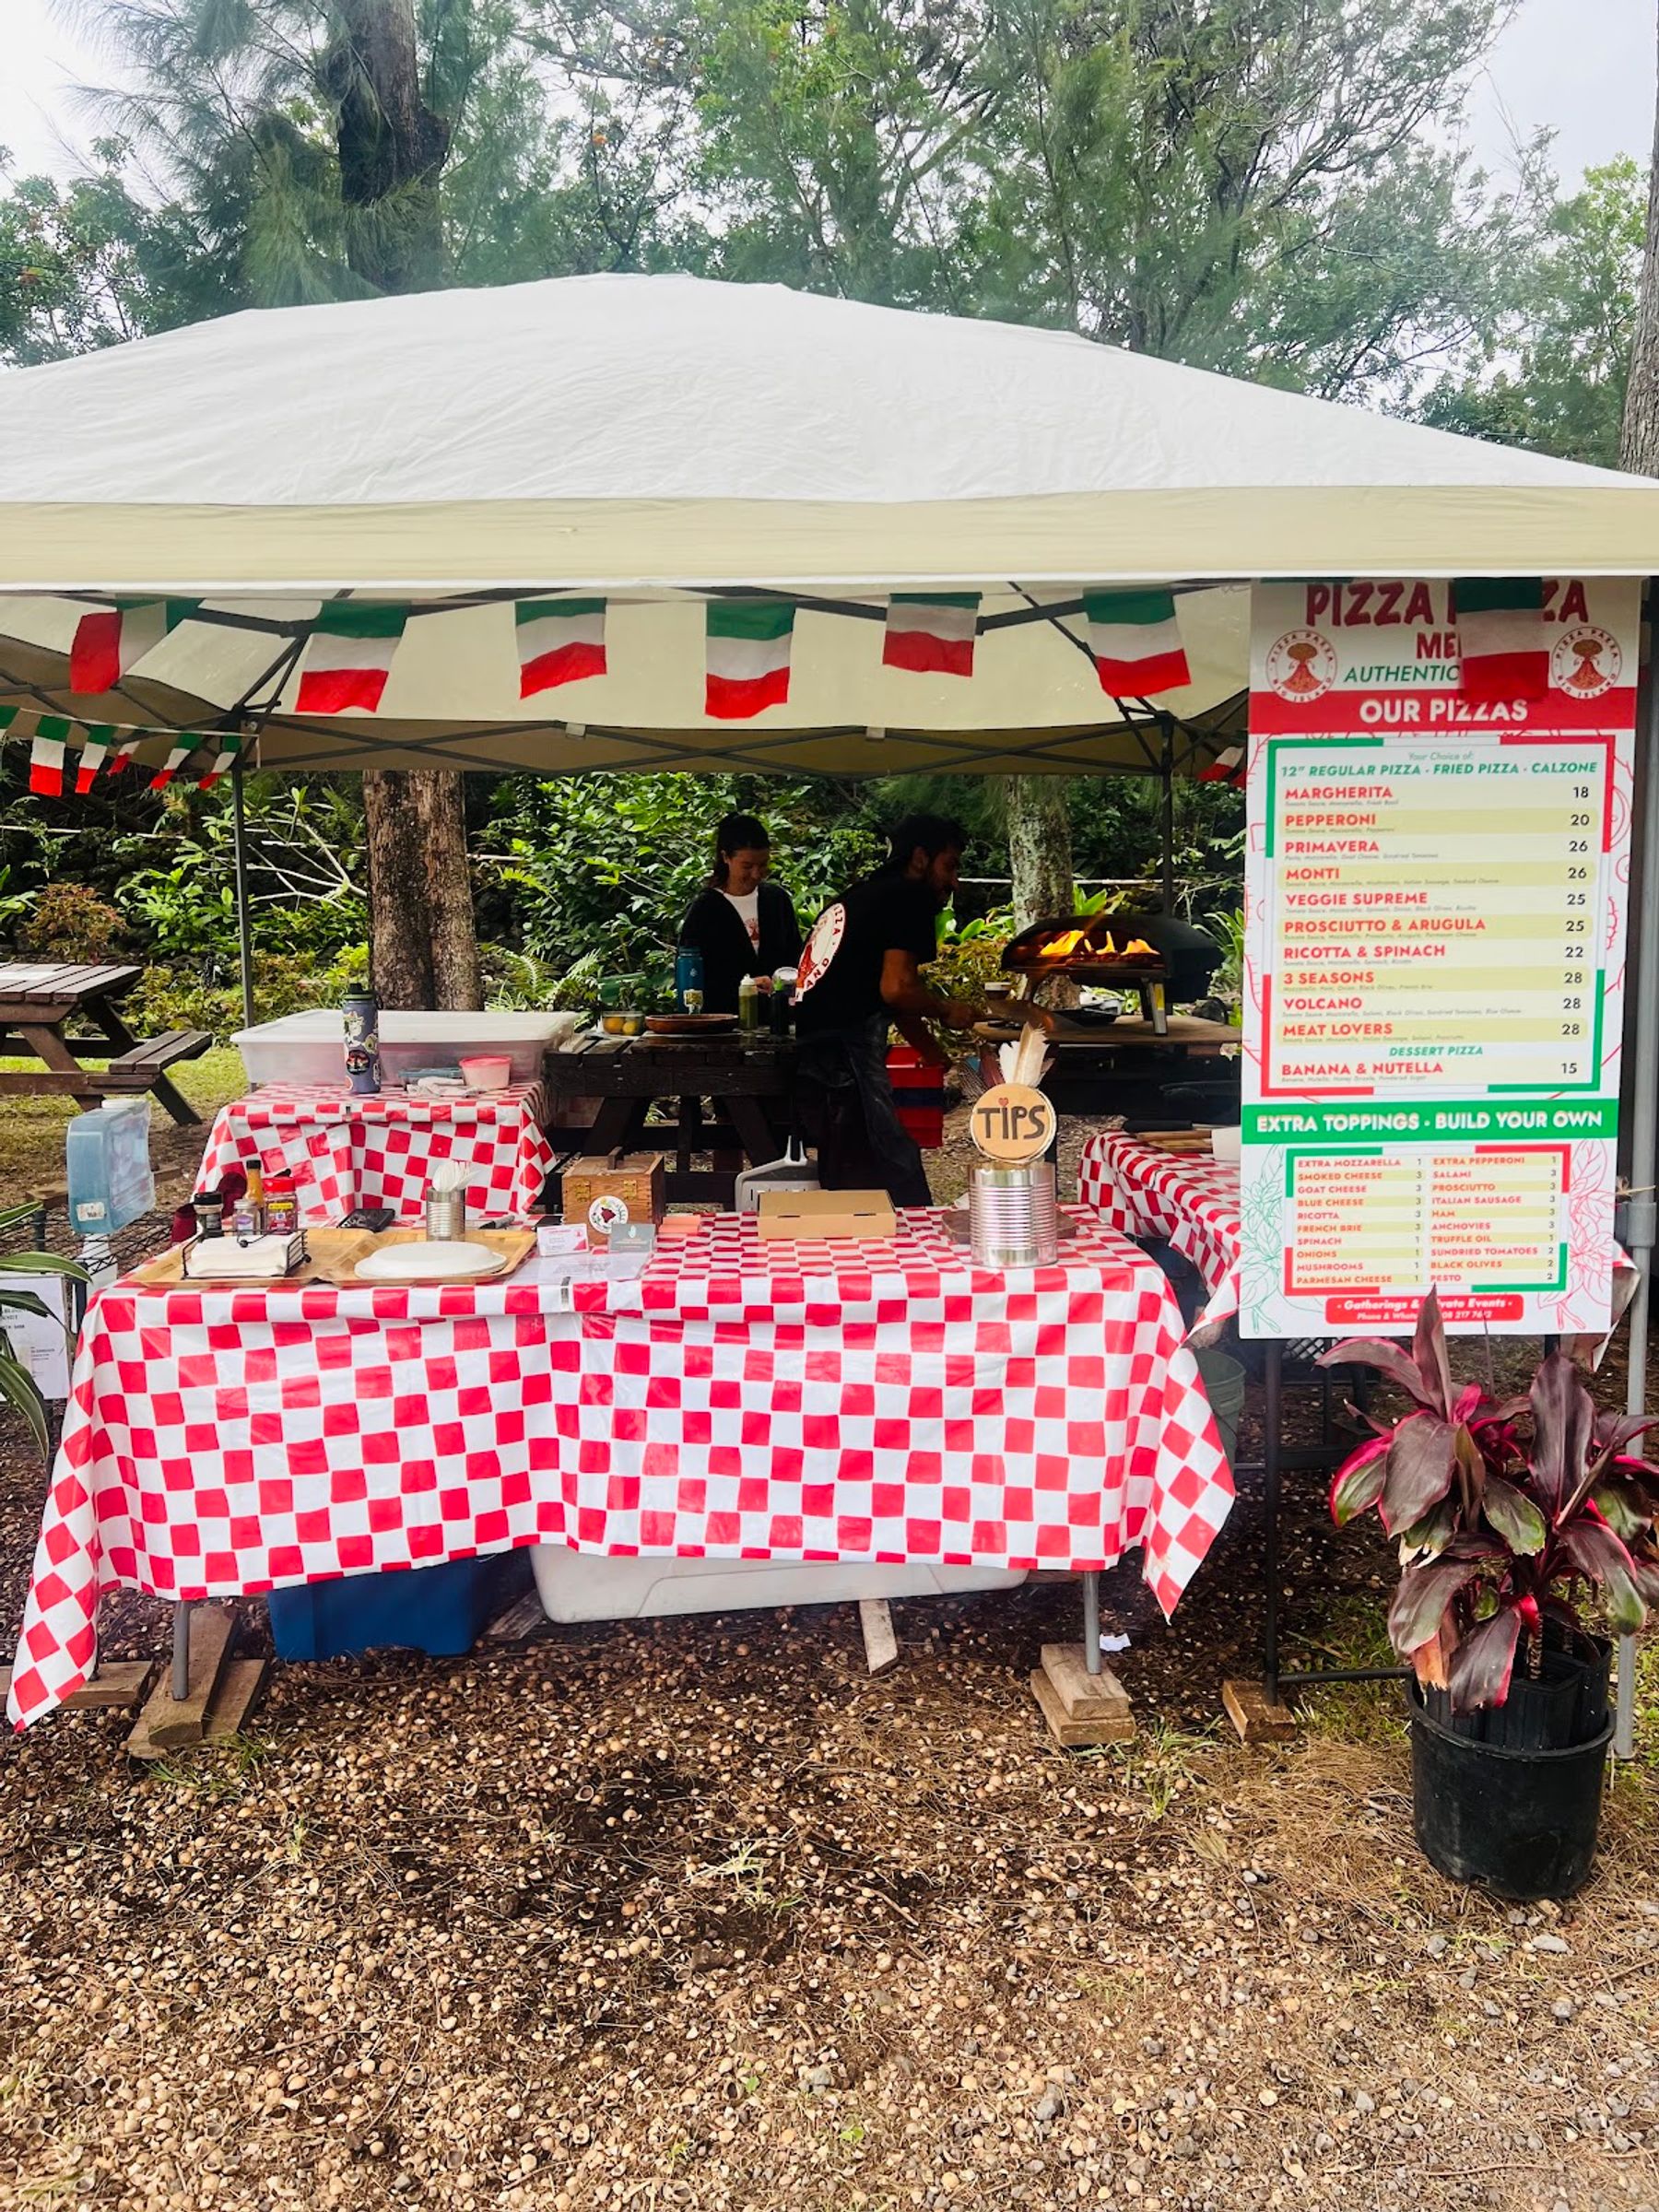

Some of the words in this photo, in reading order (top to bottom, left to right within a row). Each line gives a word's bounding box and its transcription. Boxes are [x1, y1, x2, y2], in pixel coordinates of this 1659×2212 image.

[1305, 582, 1434, 627] PIZZA
[1344, 665, 1461, 683] AUTHENTIC
[1359, 700, 1420, 724] OUR
[1430, 698, 1528, 723] PIZZAS
[1430, 751, 1461, 760] Choice
[1309, 764, 1375, 776] REGULAR
[1380, 764, 1421, 775] PIZZA
[1433, 763, 1474, 775] FRIED
[1477, 763, 1519, 774] PIZZA
[1532, 762, 1598, 773] CALZONE
[1285, 786, 1393, 799] MARGHERITA
[1572, 786, 1589, 798] 18
[1285, 814, 1376, 827] PEPPERONI
[1571, 814, 1590, 826] 20
[1285, 841, 1380, 853] PRIMAVERA
[1569, 841, 1588, 853] 26
[1286, 868, 1340, 880] MONTI
[1568, 867, 1587, 879] 26
[1286, 894, 1347, 906] VEGGIE
[1353, 892, 1428, 905] SUPREME
[1567, 893, 1586, 905] 25
[1284, 920, 1386, 933] PROSCIUTTO
[1392, 920, 1402, 932] &
[1408, 919, 1486, 931] ARUGULA
[1566, 921, 1584, 932] 25
[1284, 947, 1352, 959] RICOTTA
[1357, 946, 1368, 958] &
[1373, 945, 1445, 958] SPINACH
[1565, 947, 1583, 959] 22
[1283, 973, 1293, 985] 3
[1299, 971, 1375, 985] SEASONS
[1564, 972, 1583, 984] 28
[1283, 997, 1363, 1010] VOLCANO
[1563, 998, 1582, 1009] 28
[1283, 1024, 1327, 1037] MEAT
[1331, 1023, 1394, 1036] LOVERS
[1561, 1024, 1581, 1036] 28
[1389, 1047, 1444, 1057] DESSERT
[1447, 1046, 1483, 1055] PIZZA
[1281, 1064, 1350, 1076] BANANA
[1356, 1063, 1368, 1075] &
[1372, 1062, 1443, 1075] NUTELLA
[1561, 1063, 1577, 1074] 15
[1256, 1115, 1318, 1133] EXTRA
[1323, 1112, 1419, 1132] TOPPINGS
[1434, 1112, 1490, 1130] BUILD
[1496, 1112, 1549, 1129] YOUR
[1553, 1110, 1602, 1128] OWN
[1334, 1159, 1401, 1168] MOZZARELLA
[1433, 1158, 1465, 1166] EXTRA
[1469, 1157, 1525, 1165] PEPPERONI
[1432, 1171, 1472, 1179] SALAMI
[1328, 1185, 1367, 1194] CHEESE
[1432, 1183, 1496, 1192] PROSCIUTTO
[1298, 1199, 1323, 1207] BLUE
[1325, 1198, 1364, 1206] CHEESE
[1431, 1196, 1471, 1205] ITALIAN
[1474, 1196, 1522, 1205] SAUSAGE
[1298, 1212, 1340, 1220] RICOTTA
[1340, 1224, 1362, 1232] BRIE
[1431, 1222, 1491, 1230] ANCHOVIES
[1297, 1238, 1342, 1246] SPINACH
[1431, 1235, 1472, 1243] TRUFFLE
[1430, 1248, 1481, 1256] SUNDRIED
[1484, 1247, 1538, 1255] TOMATOES
[1430, 1261, 1463, 1269] BLACK
[1296, 1277, 1352, 1285] PARMESAN
[1344, 1299, 1407, 1312] Gatherings
[1410, 1299, 1419, 1309] &
[1468, 1298, 1506, 1309] Events
[1441, 1311, 1453, 1319] 08
